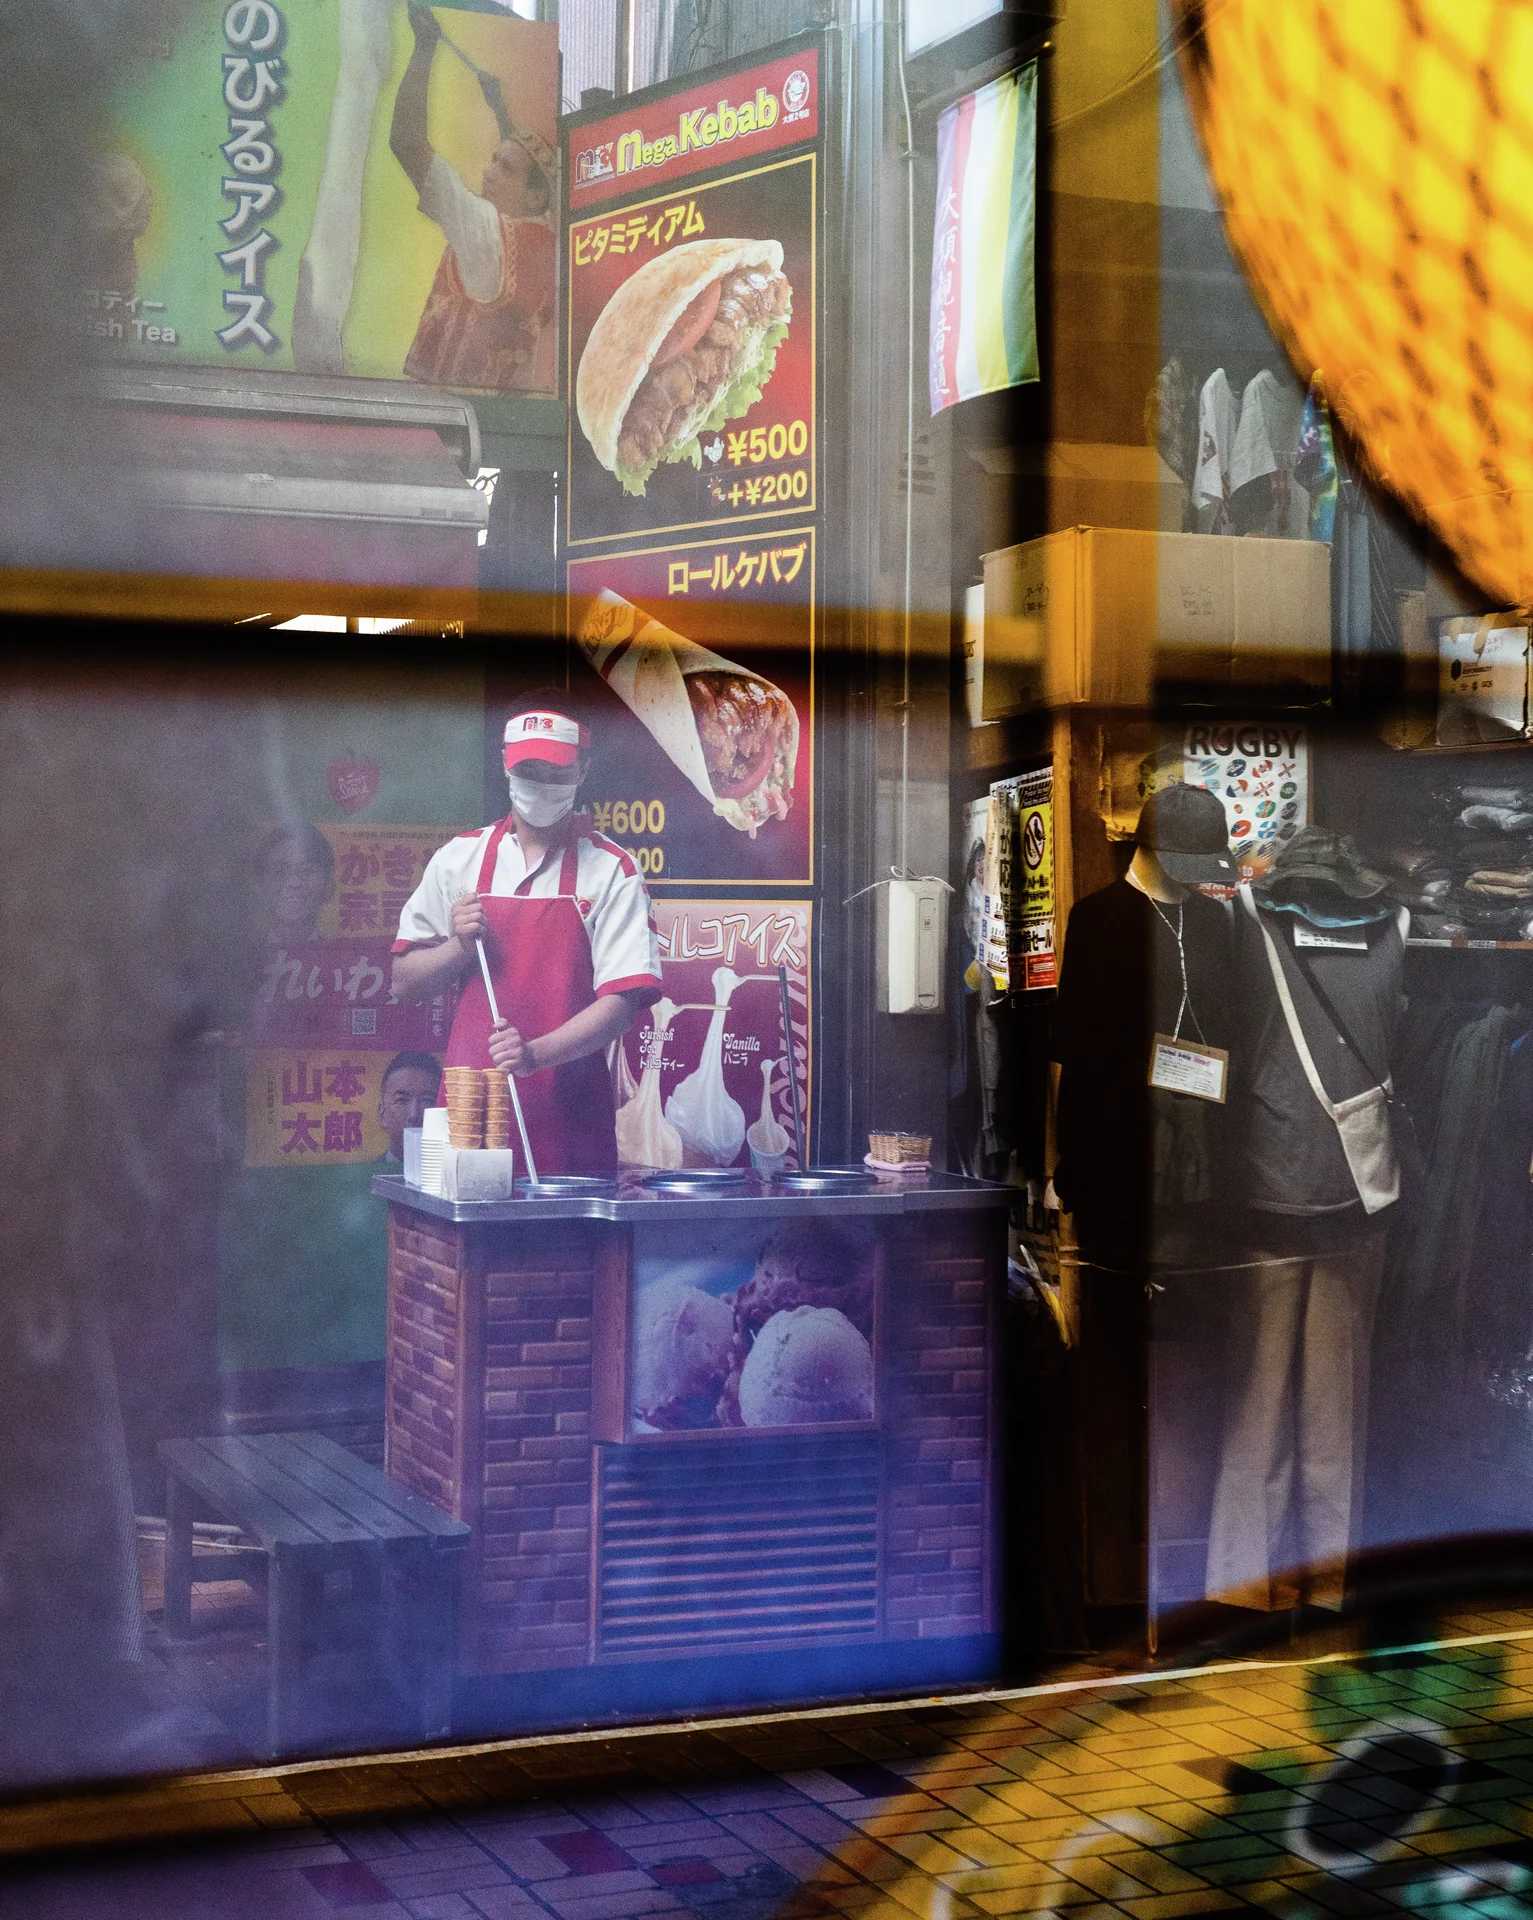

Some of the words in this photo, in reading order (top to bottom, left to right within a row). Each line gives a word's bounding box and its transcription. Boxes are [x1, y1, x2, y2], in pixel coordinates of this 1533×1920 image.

[617, 129, 678, 175] Mega
[680, 87, 779, 154] Kebab
[216, 0, 285, 352] のびるアイス
[575, 200, 706, 266] ピタミディアム
[132, 319, 176, 343] Tea
[727, 420, 808, 466] ¥500
[727, 470, 808, 508] +¥200
[667, 542, 807, 594] ロールケバブ
[1190, 726, 1303, 759] RUGBY
[592, 800, 665, 834] ¥600
[640, 1025, 675, 1041] Turkish
[640, 1040, 657, 1054] Tea
[723, 1033, 760, 1052] Vanilla
[640, 1056, 685, 1071] トルコティー
[723, 1051, 748, 1065] バニラ
[282, 1061, 366, 1105] 山本
[282, 1111, 364, 1153] 太郎
